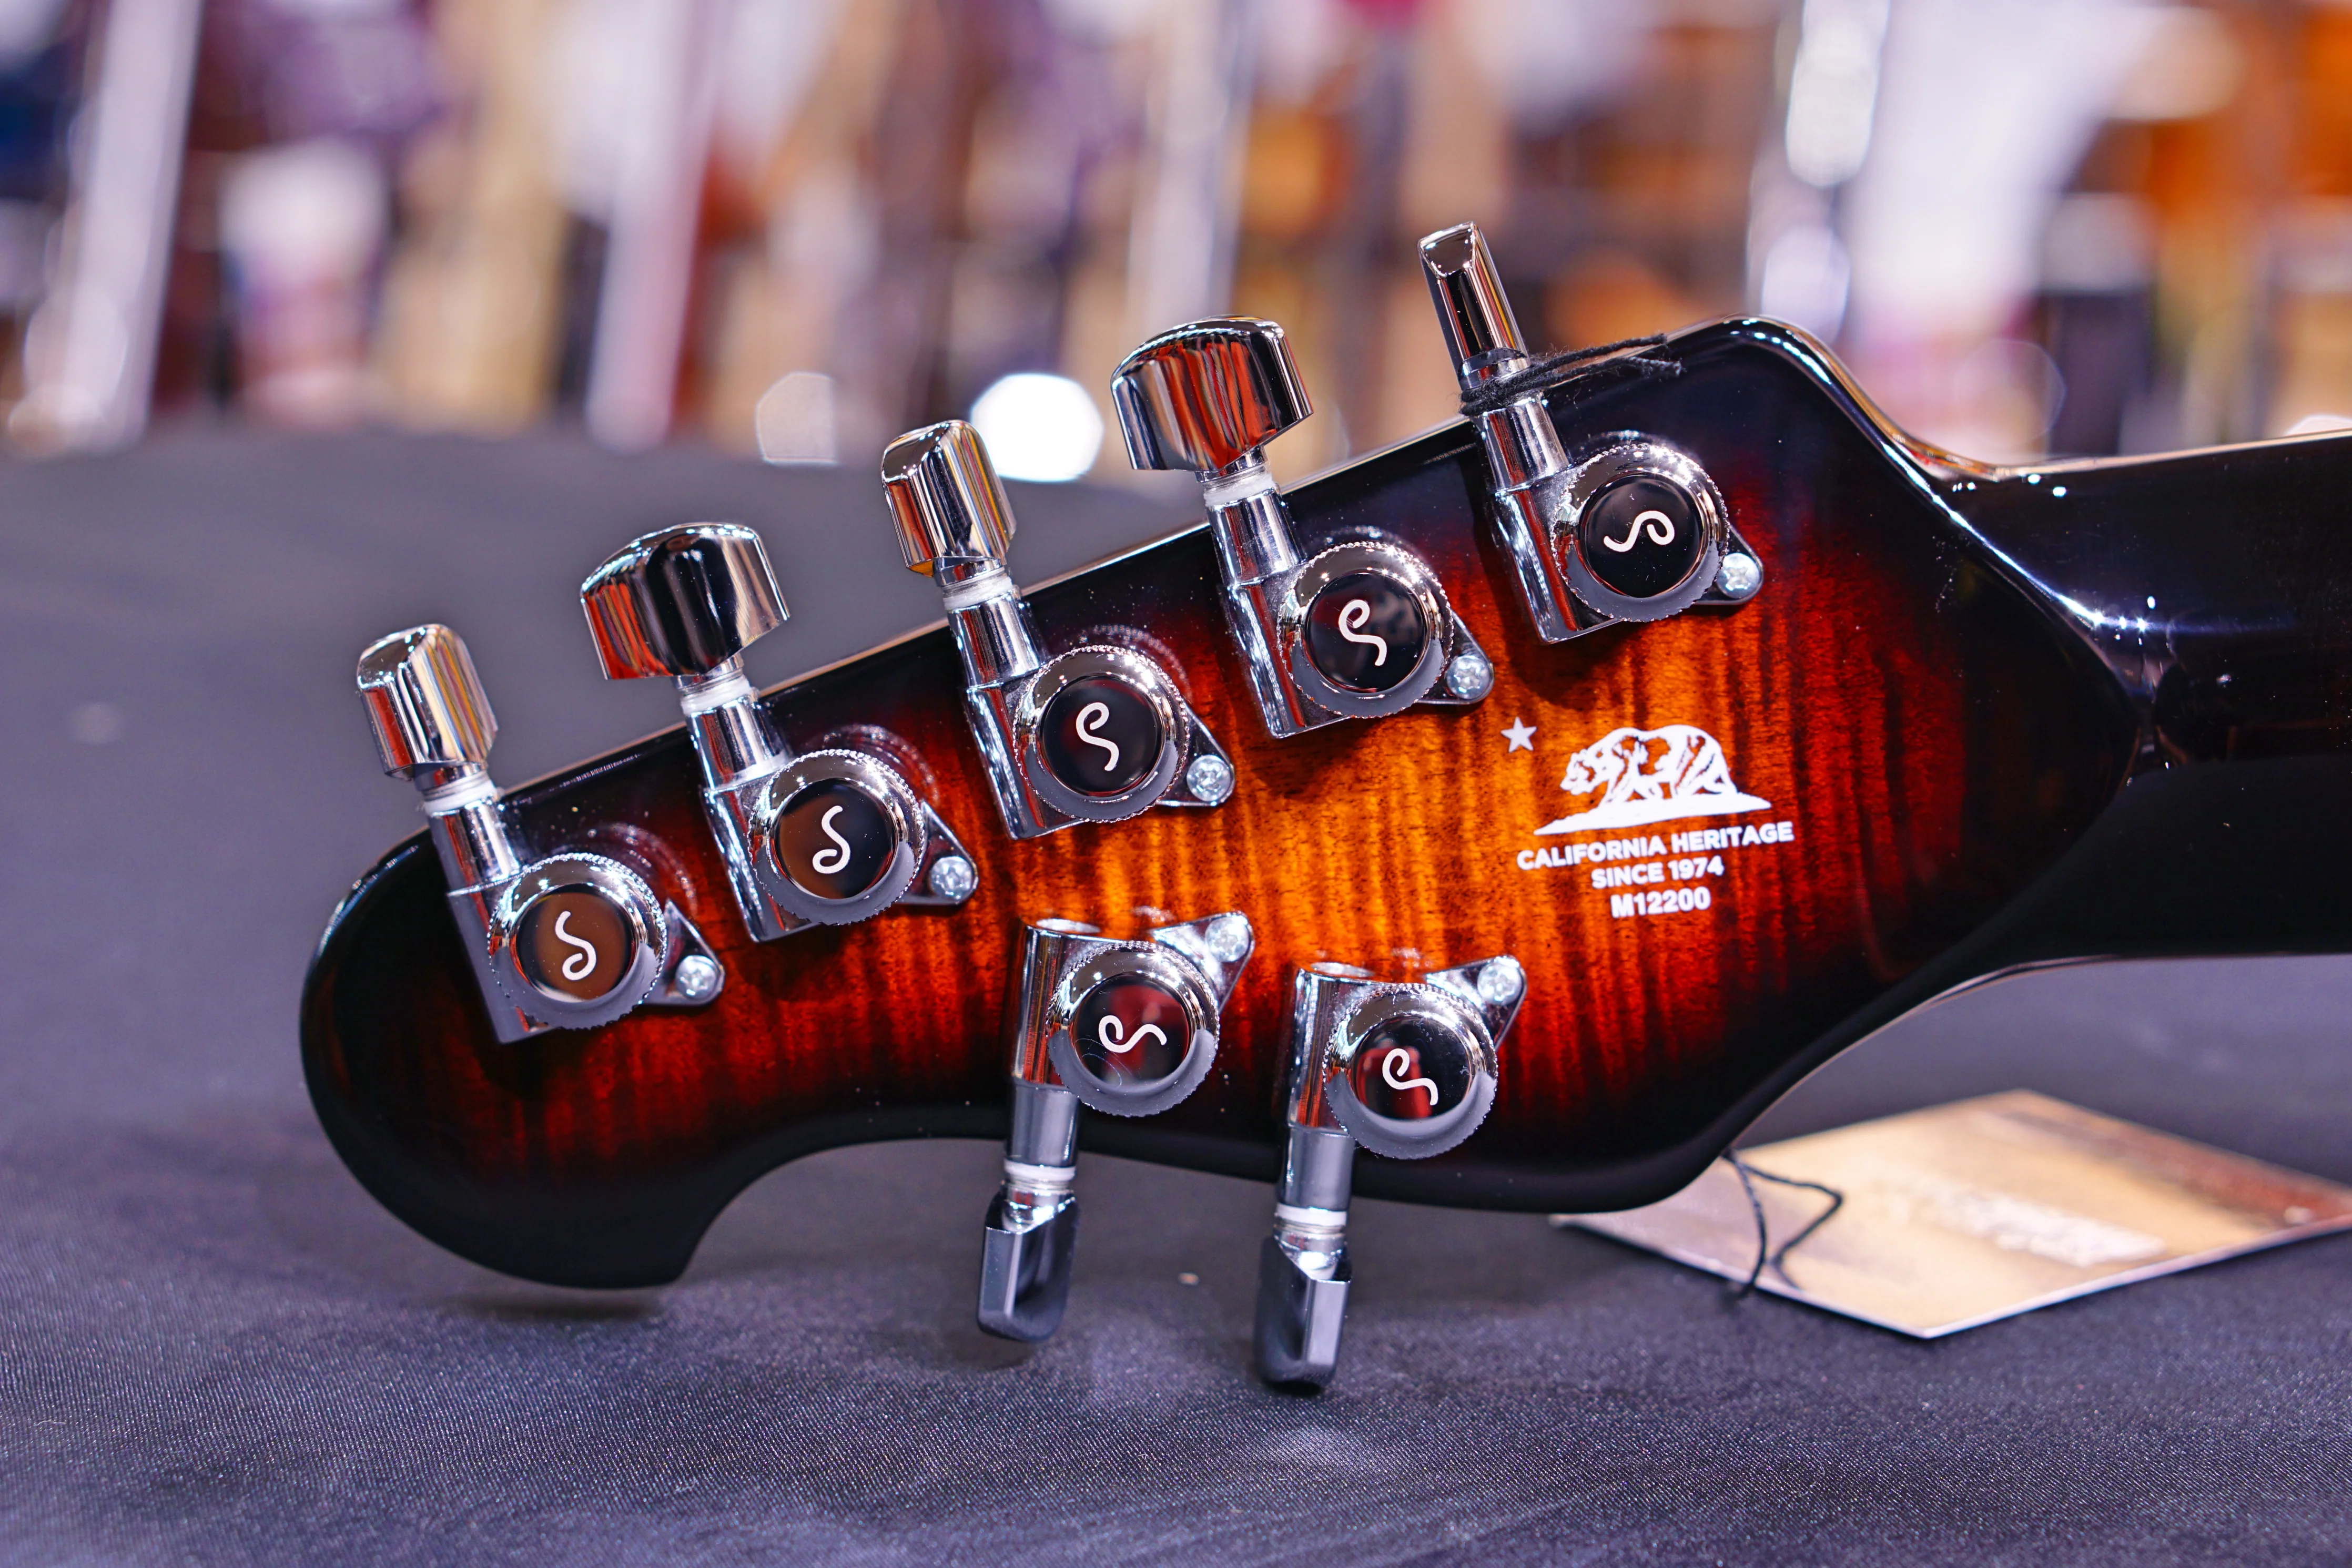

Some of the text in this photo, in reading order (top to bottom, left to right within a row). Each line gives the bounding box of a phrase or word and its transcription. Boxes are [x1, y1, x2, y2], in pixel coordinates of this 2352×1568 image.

[1517, 821, 1795, 871] CALIFORNIA HERITAGE
[1591, 855, 1725, 889] SINCE 1974
[1610, 886, 1711, 918] M12200
